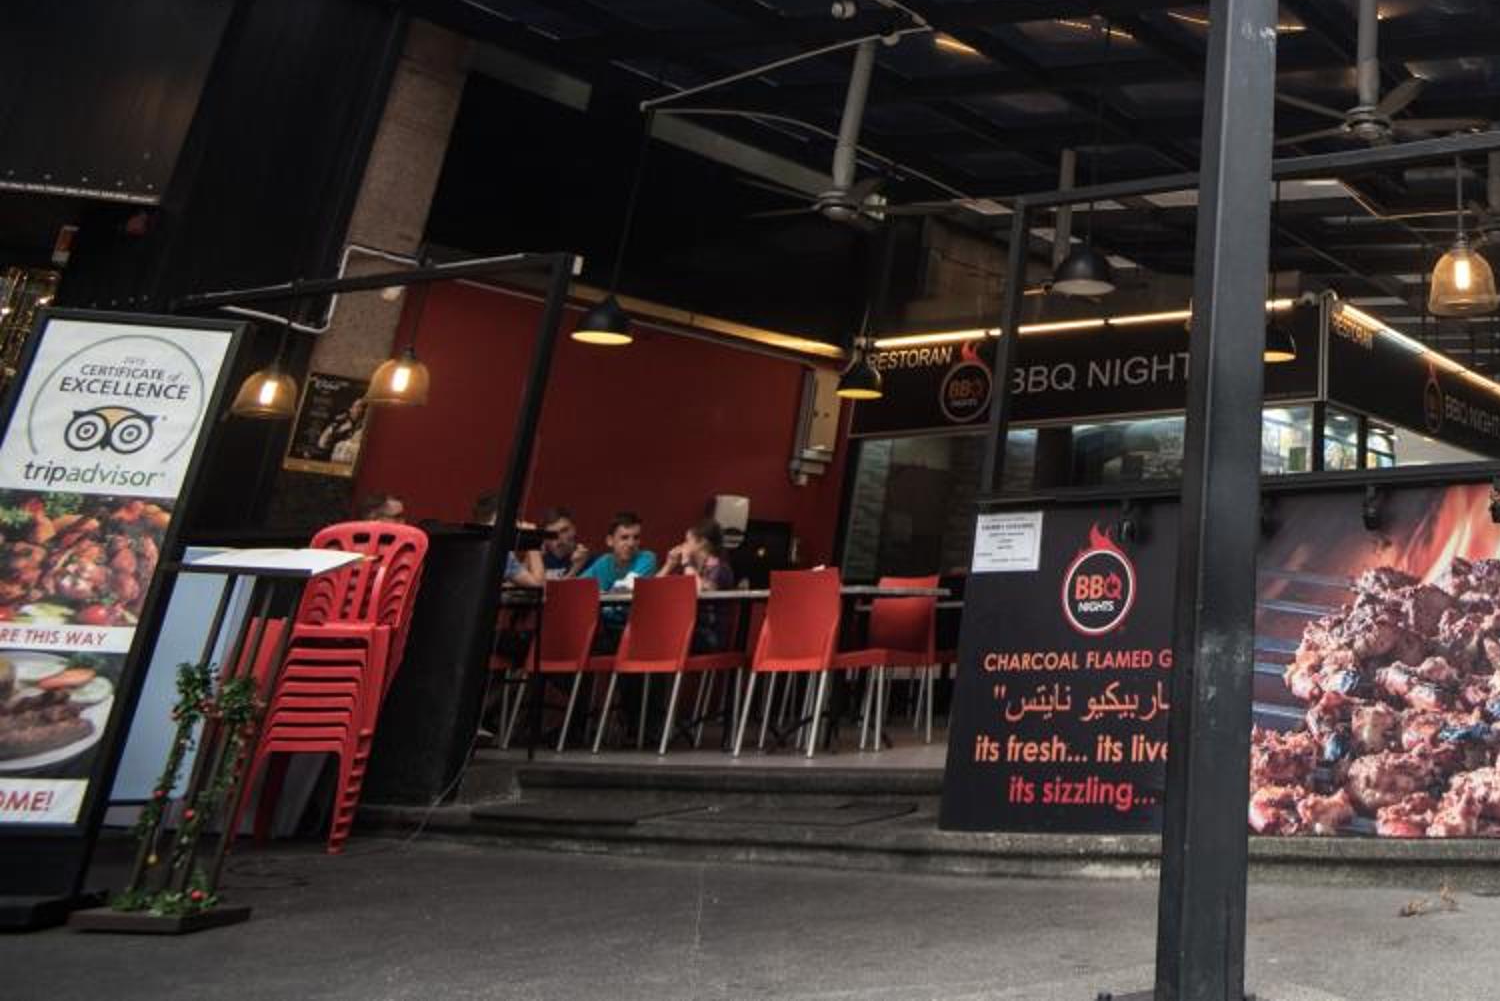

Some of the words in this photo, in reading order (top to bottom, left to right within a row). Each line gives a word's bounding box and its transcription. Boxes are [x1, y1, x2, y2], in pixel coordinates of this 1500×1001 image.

[867, 346, 953, 370] RESTORAN
[80, 364, 165, 381] CERTIFICATE
[168, 372, 181, 383] of
[59, 376, 191, 400] EXCELLENCE
[24, 460, 159, 487] tripadvisor
[1075, 574, 1122, 600] BBQ
[1078, 601, 1114, 613] NIGHTS
[24, 630, 60, 644] THIS
[66, 630, 107, 646] WAY
[984, 652, 1079, 672] CHARCOAL
[1085, 651, 1153, 670] FLAMED
[975, 735, 999, 762] its
[1007, 735, 1088, 762] fresh...
[1097, 735, 1122, 762] its
[1009, 776, 1034, 804] its
[1043, 776, 1155, 810] sizzling...
